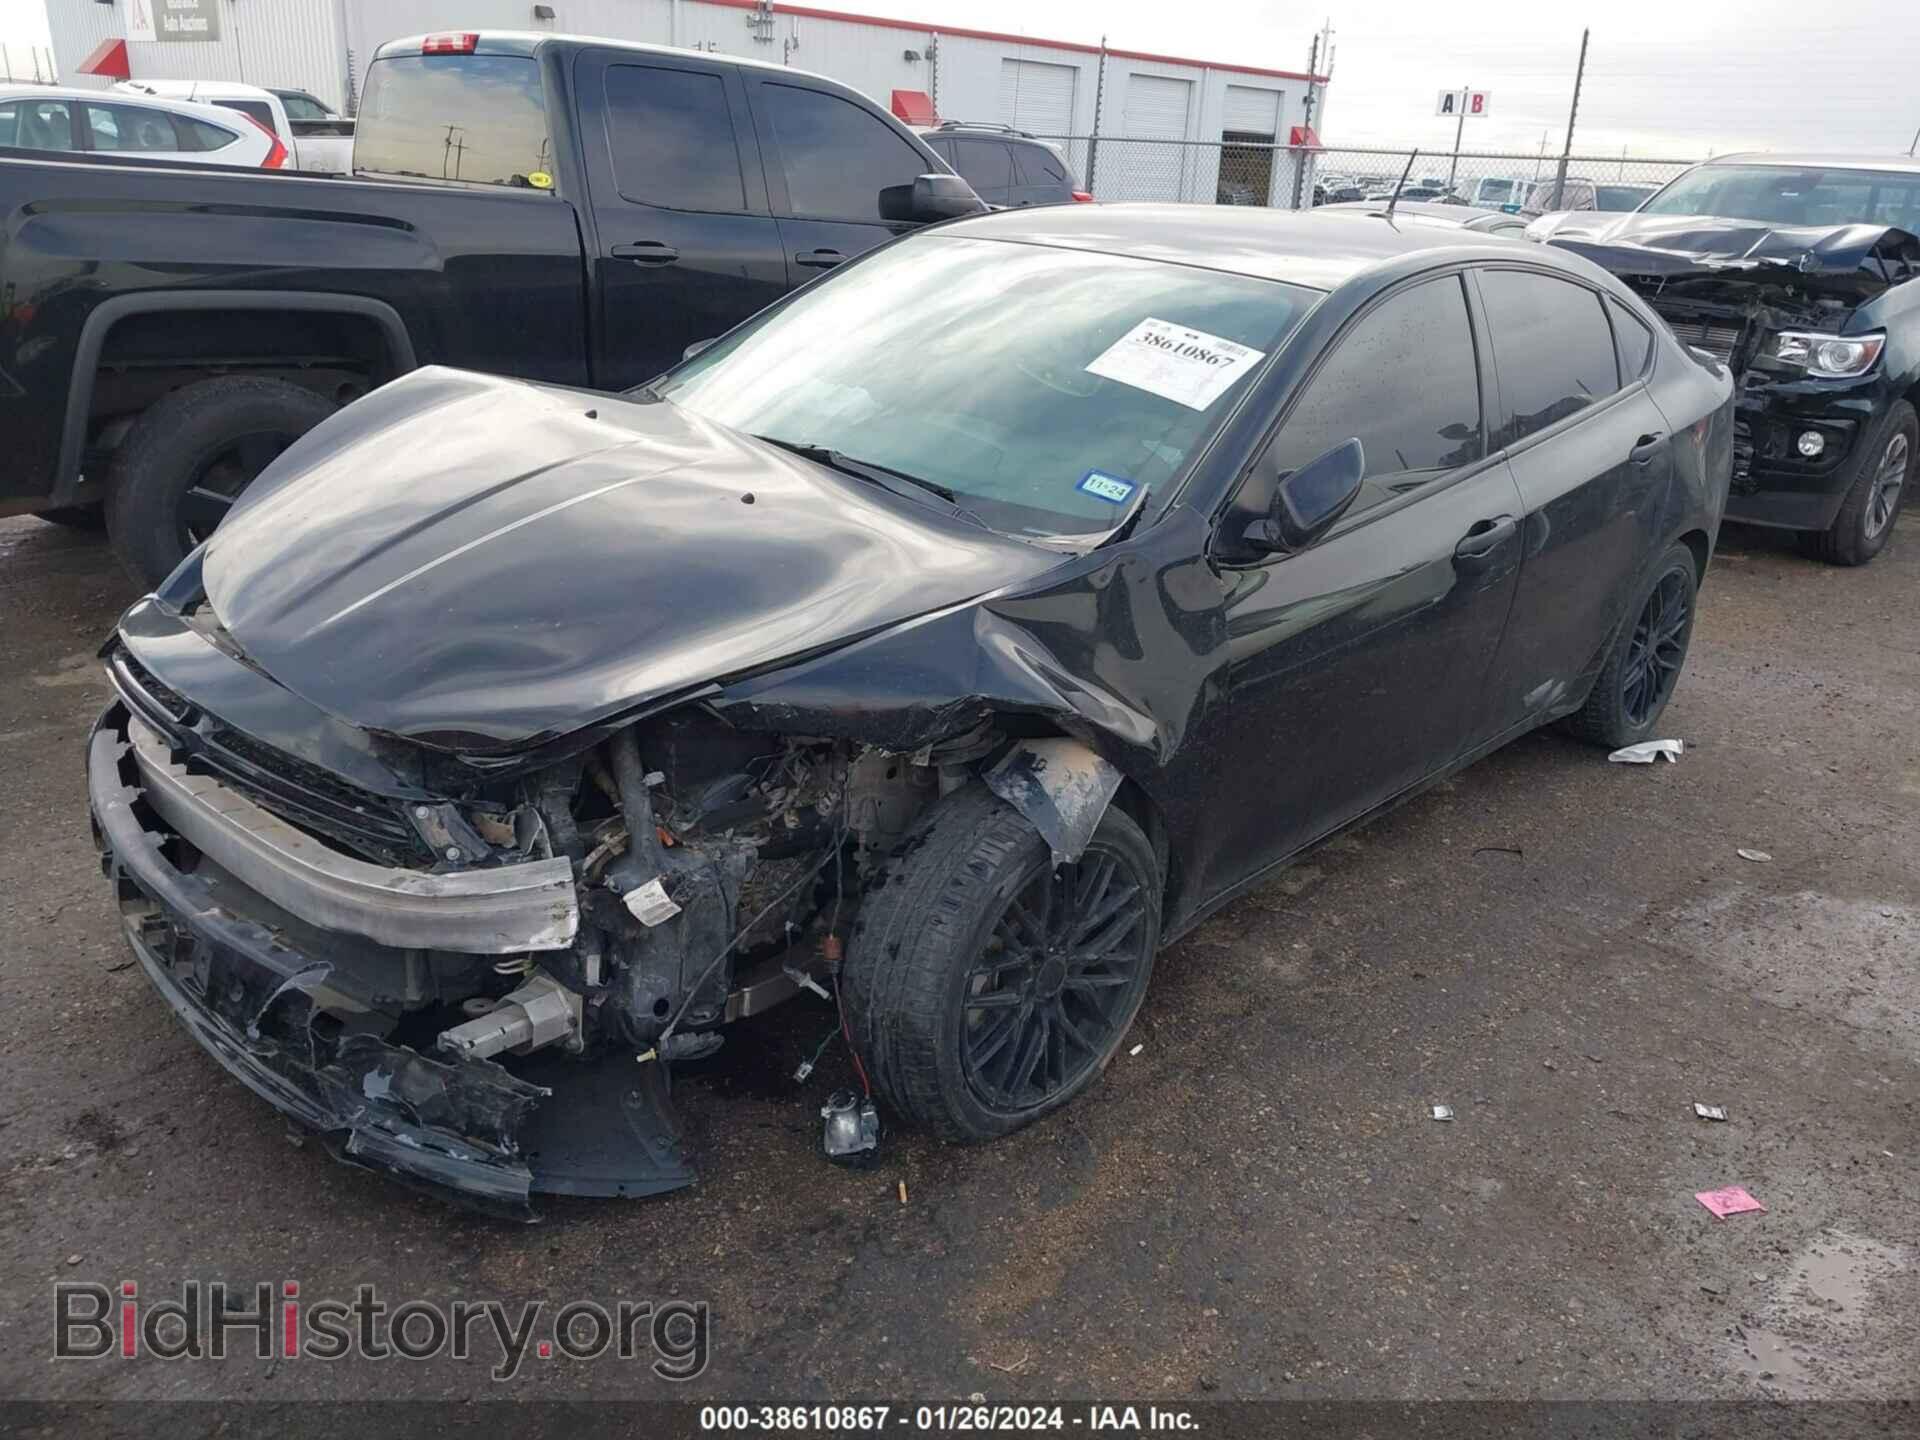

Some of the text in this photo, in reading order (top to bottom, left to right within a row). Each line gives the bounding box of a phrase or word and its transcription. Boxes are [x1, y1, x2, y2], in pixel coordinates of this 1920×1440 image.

[1441, 93, 1484, 114] A B
[1136, 331, 1236, 369] 38610867
